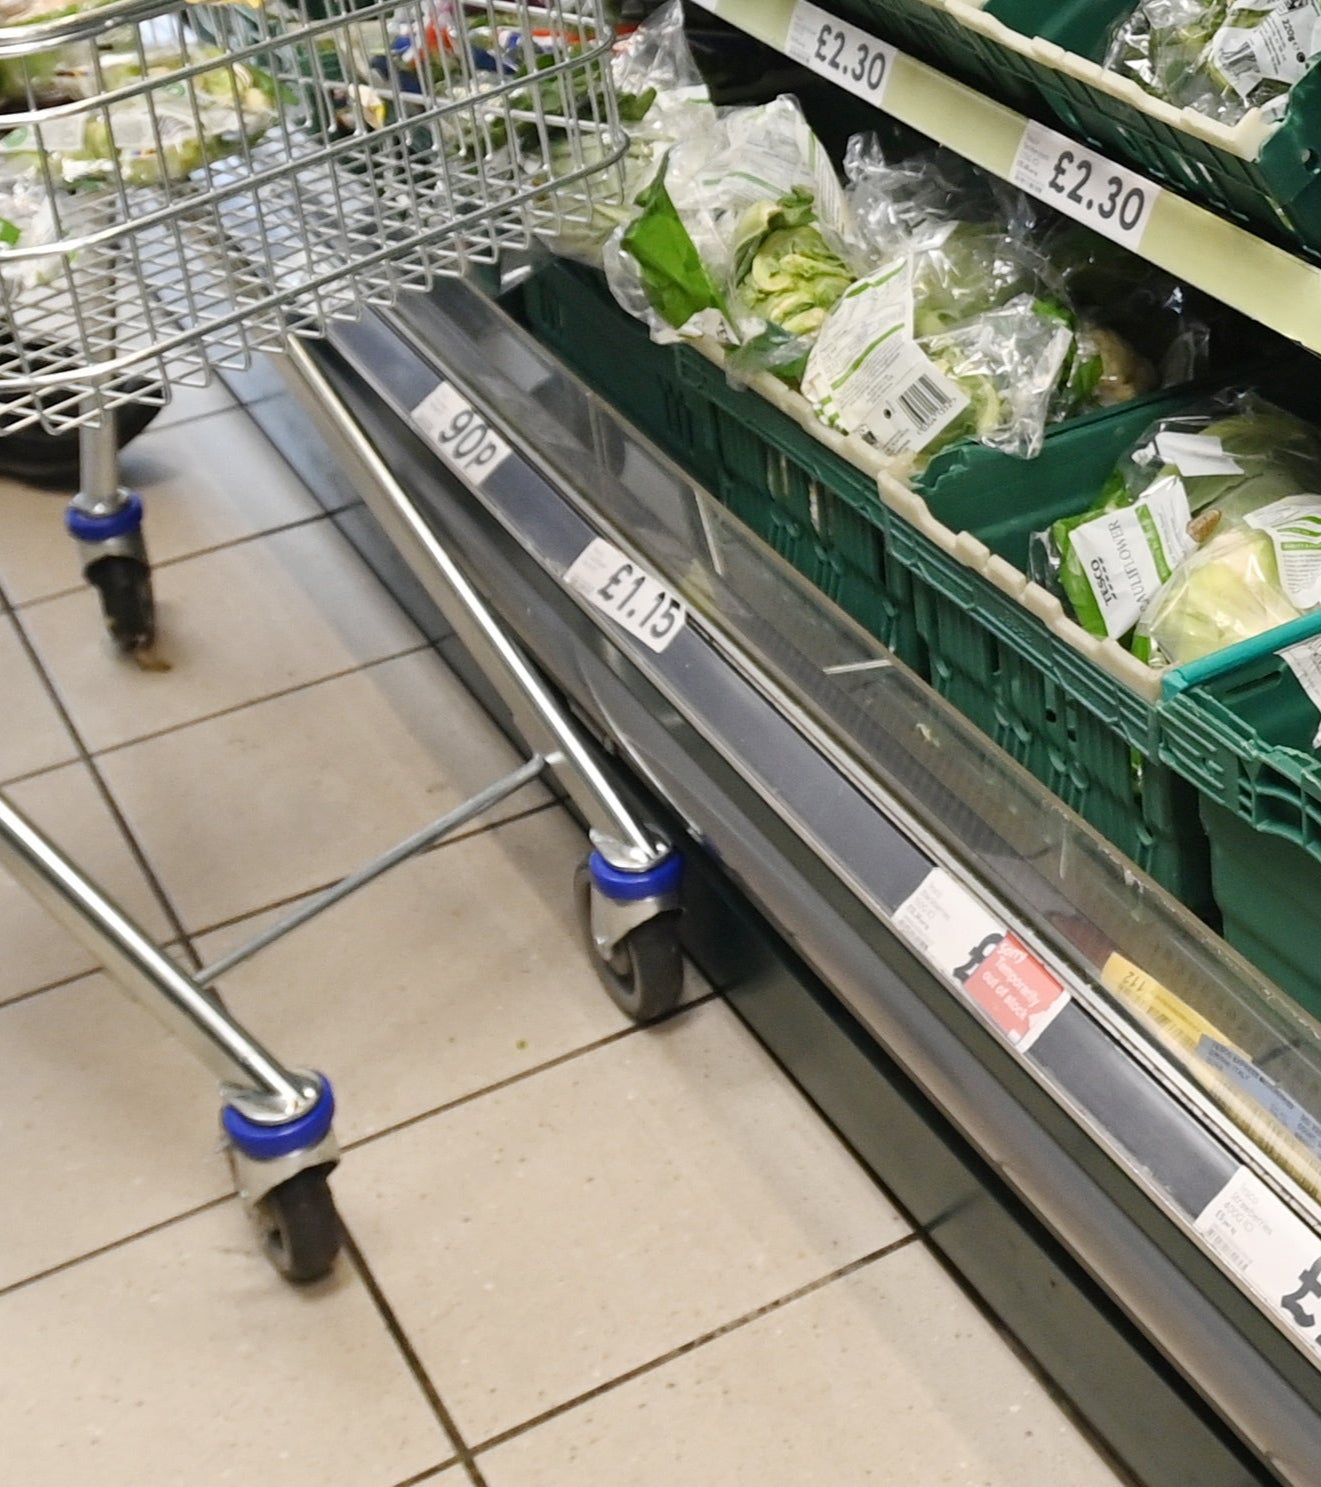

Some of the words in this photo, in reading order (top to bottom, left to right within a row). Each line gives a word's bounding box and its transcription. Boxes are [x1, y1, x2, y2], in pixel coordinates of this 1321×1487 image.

[813, 22, 887, 92] £2.30
[1281, 18, 1297, 43] 220g
[1047, 150, 1146, 232] £2.30
[437, 408, 498, 470] 90p
[597, 563, 685, 639] £1.15
[1090, 557, 1115, 608] TESCO
[981, 970, 1000, 989] out
[994, 984, 1011, 998] of
[1003, 993, 1029, 1022] stock
[994, 958, 1041, 1009] Temporarily
